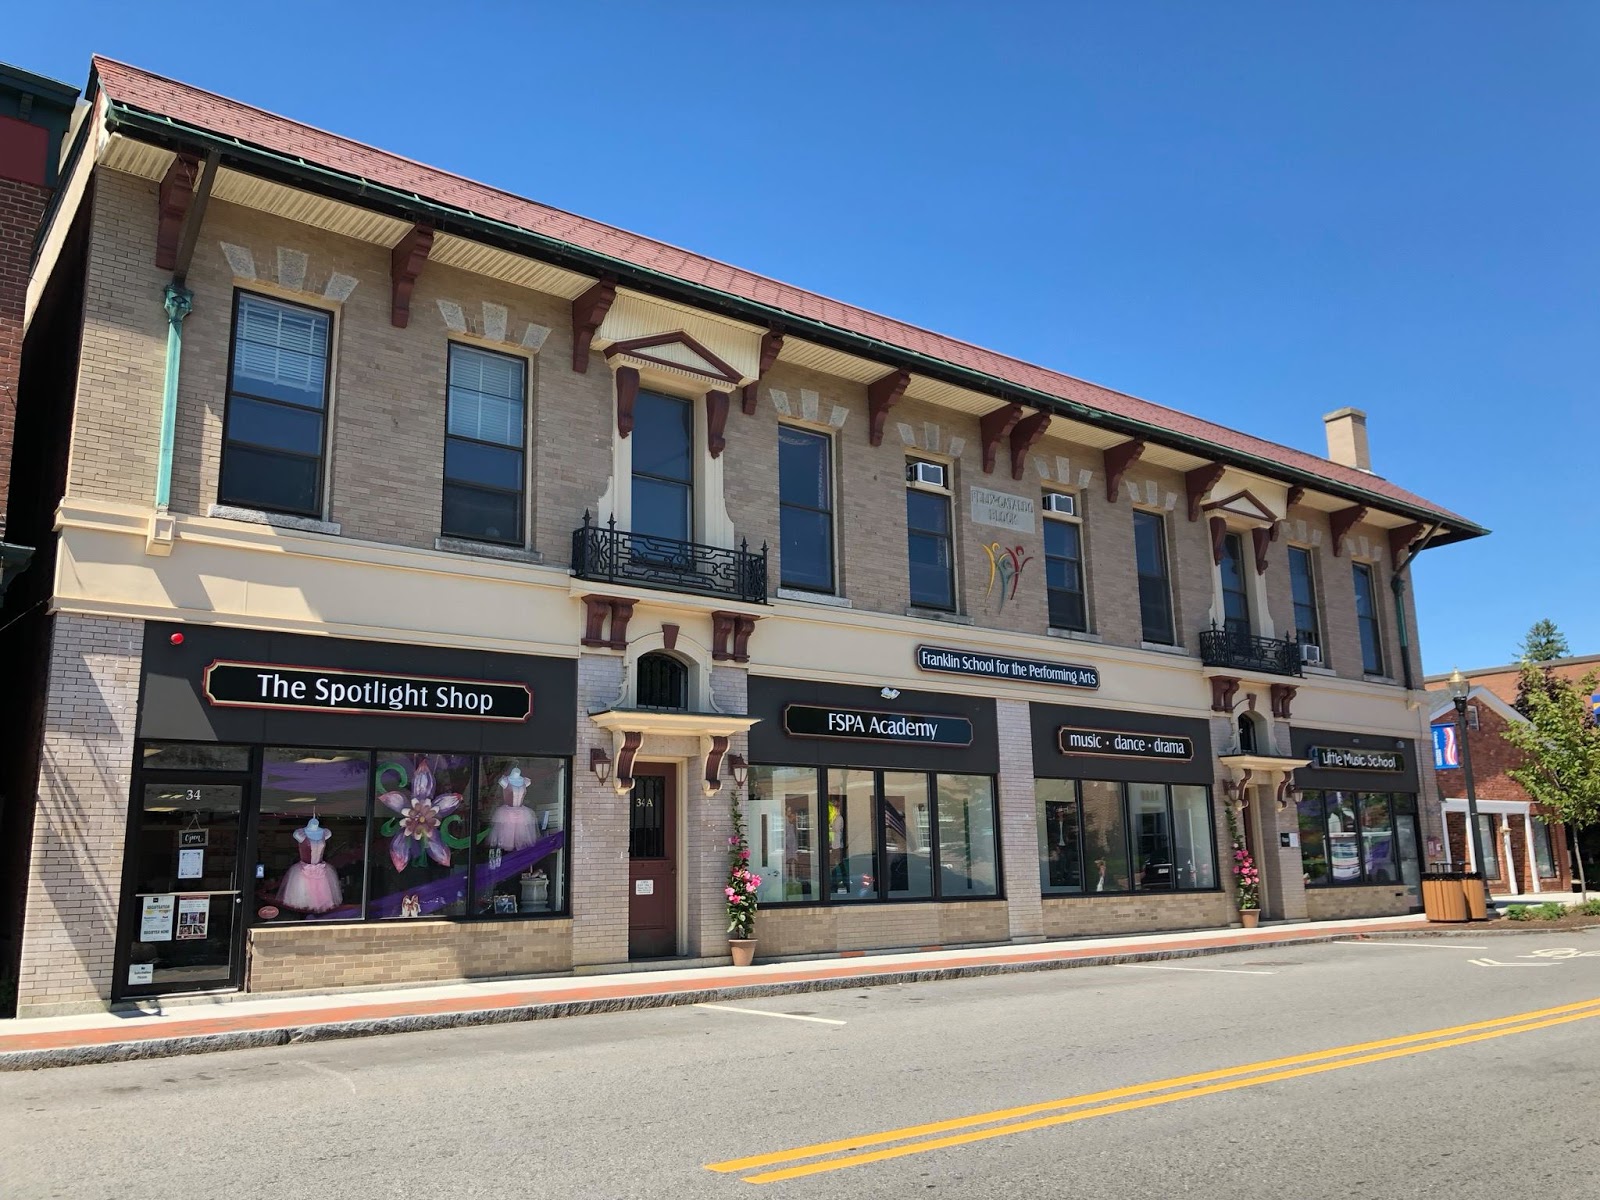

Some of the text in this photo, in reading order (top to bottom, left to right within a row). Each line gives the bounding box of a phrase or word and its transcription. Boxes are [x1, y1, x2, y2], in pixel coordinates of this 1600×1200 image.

[922, 651, 1097, 685] Franklin School for the Performing Arts
[257, 673, 493, 714] The Spotlight Shop
[828, 713, 938, 740] FSPA Academy
[1070, 734, 1185, 754] music dance drama
[1322, 750, 1396, 768] Little Music School
[185, 789, 201, 800] 34
[184, 833, 203, 843] Open
